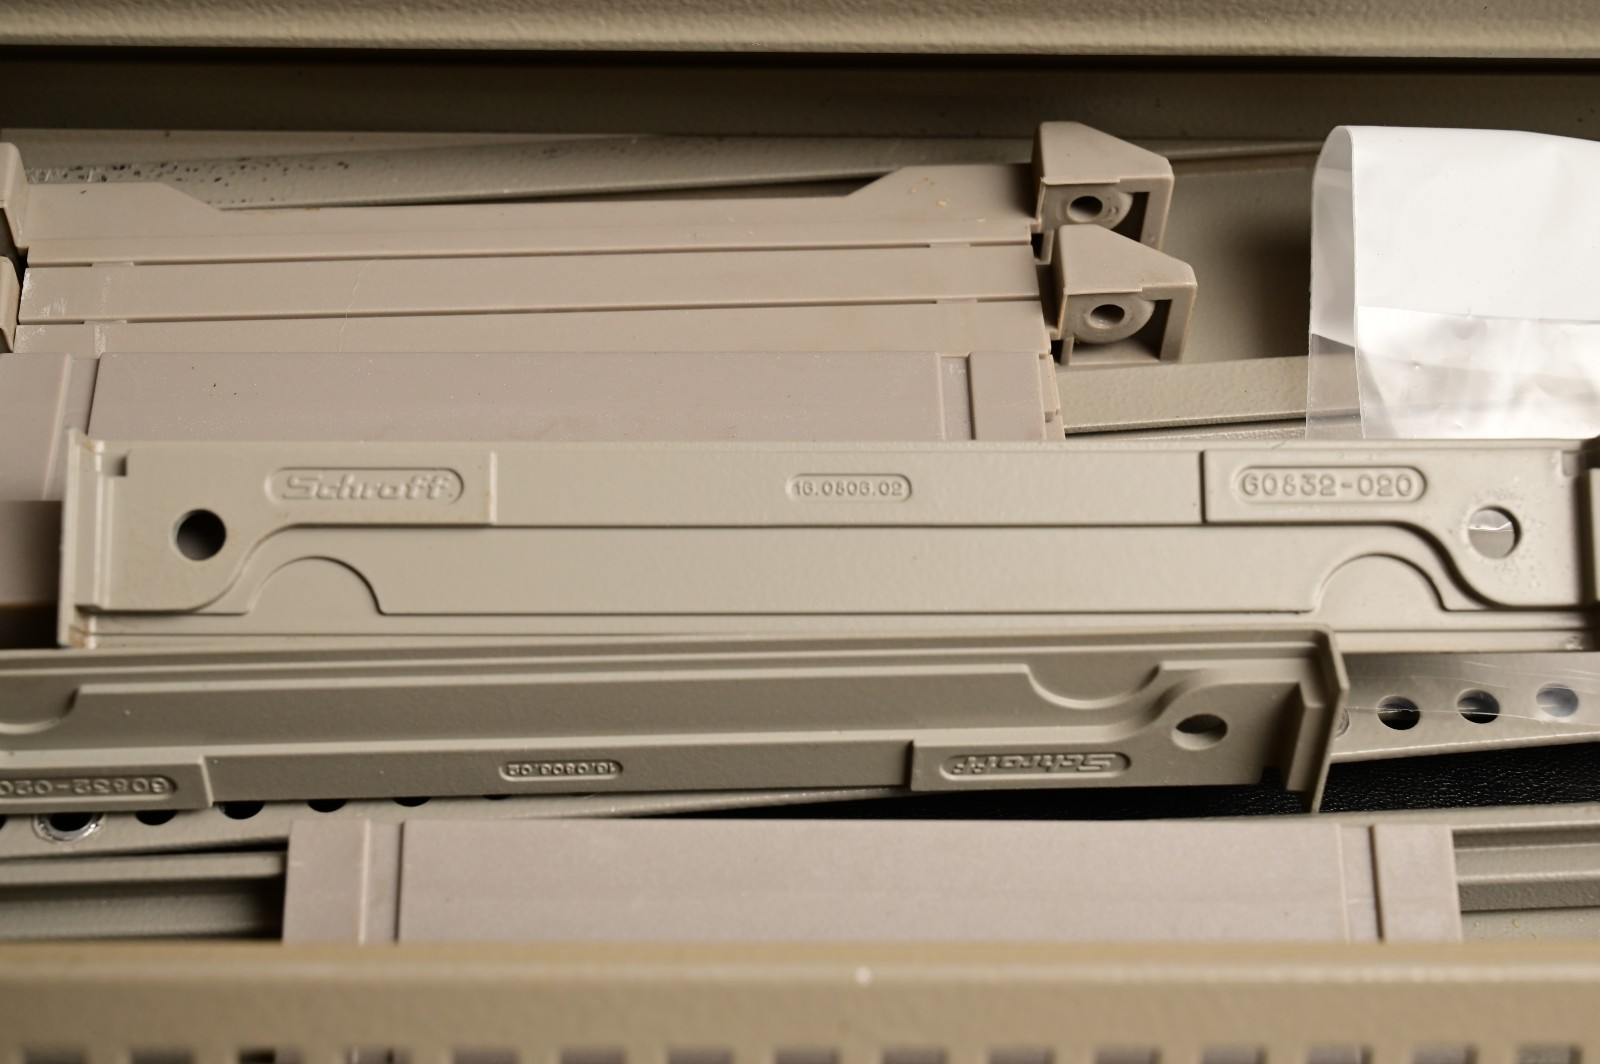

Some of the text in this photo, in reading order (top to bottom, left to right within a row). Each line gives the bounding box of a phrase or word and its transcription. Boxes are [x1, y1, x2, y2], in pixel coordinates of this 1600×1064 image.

[281, 474, 451, 500] Schroff
[793, 479, 904, 497] 16.0806.02
[1241, 472, 1413, 497] 60832-020
[951, 753, 1115, 774] Schroff
